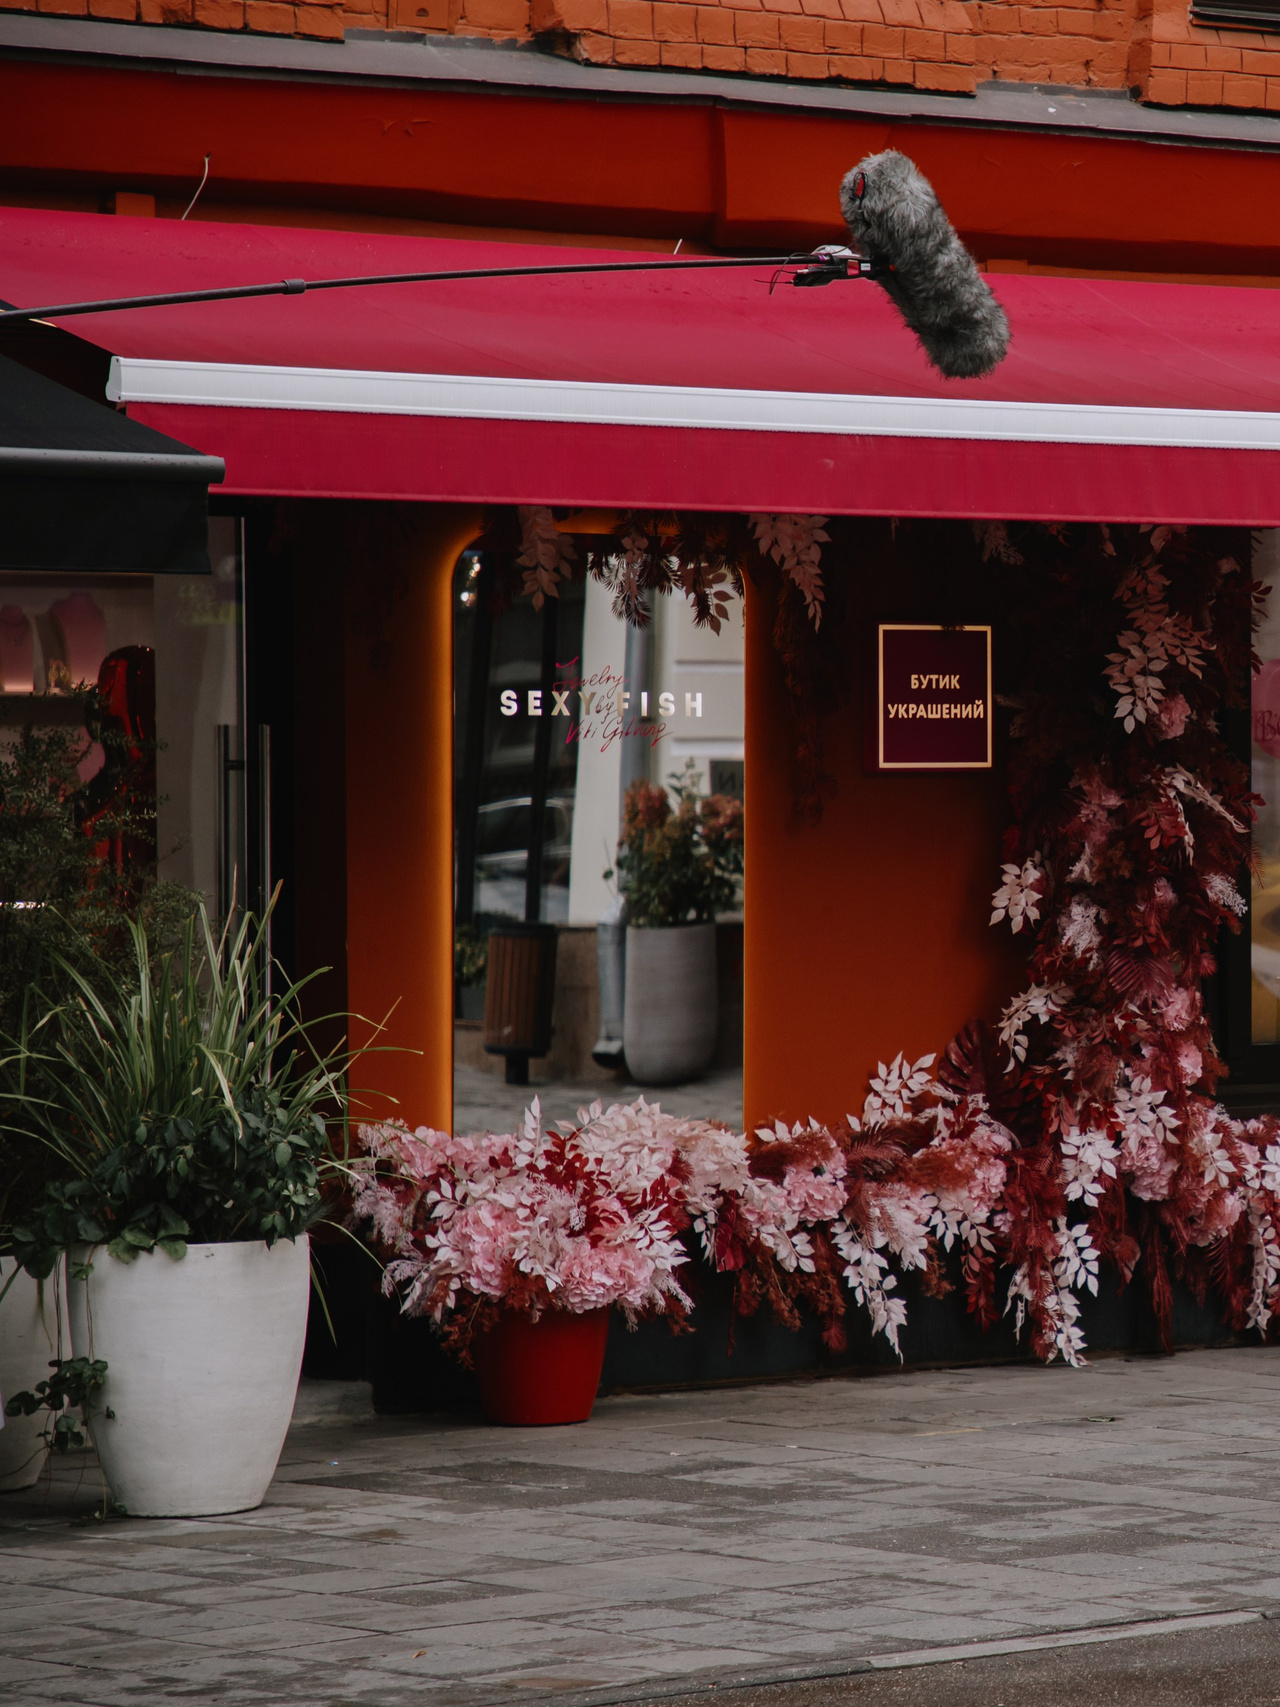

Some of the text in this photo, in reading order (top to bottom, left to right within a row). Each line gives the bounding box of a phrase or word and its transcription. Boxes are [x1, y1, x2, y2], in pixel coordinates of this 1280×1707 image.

[553, 655, 630, 699] Jewelry
[910, 674, 961, 689] БУТИК
[500, 689, 703, 718] SEXY FISH
[595, 695, 617, 724] by
[887, 699, 984, 719] УКРАШЕНИЙ
